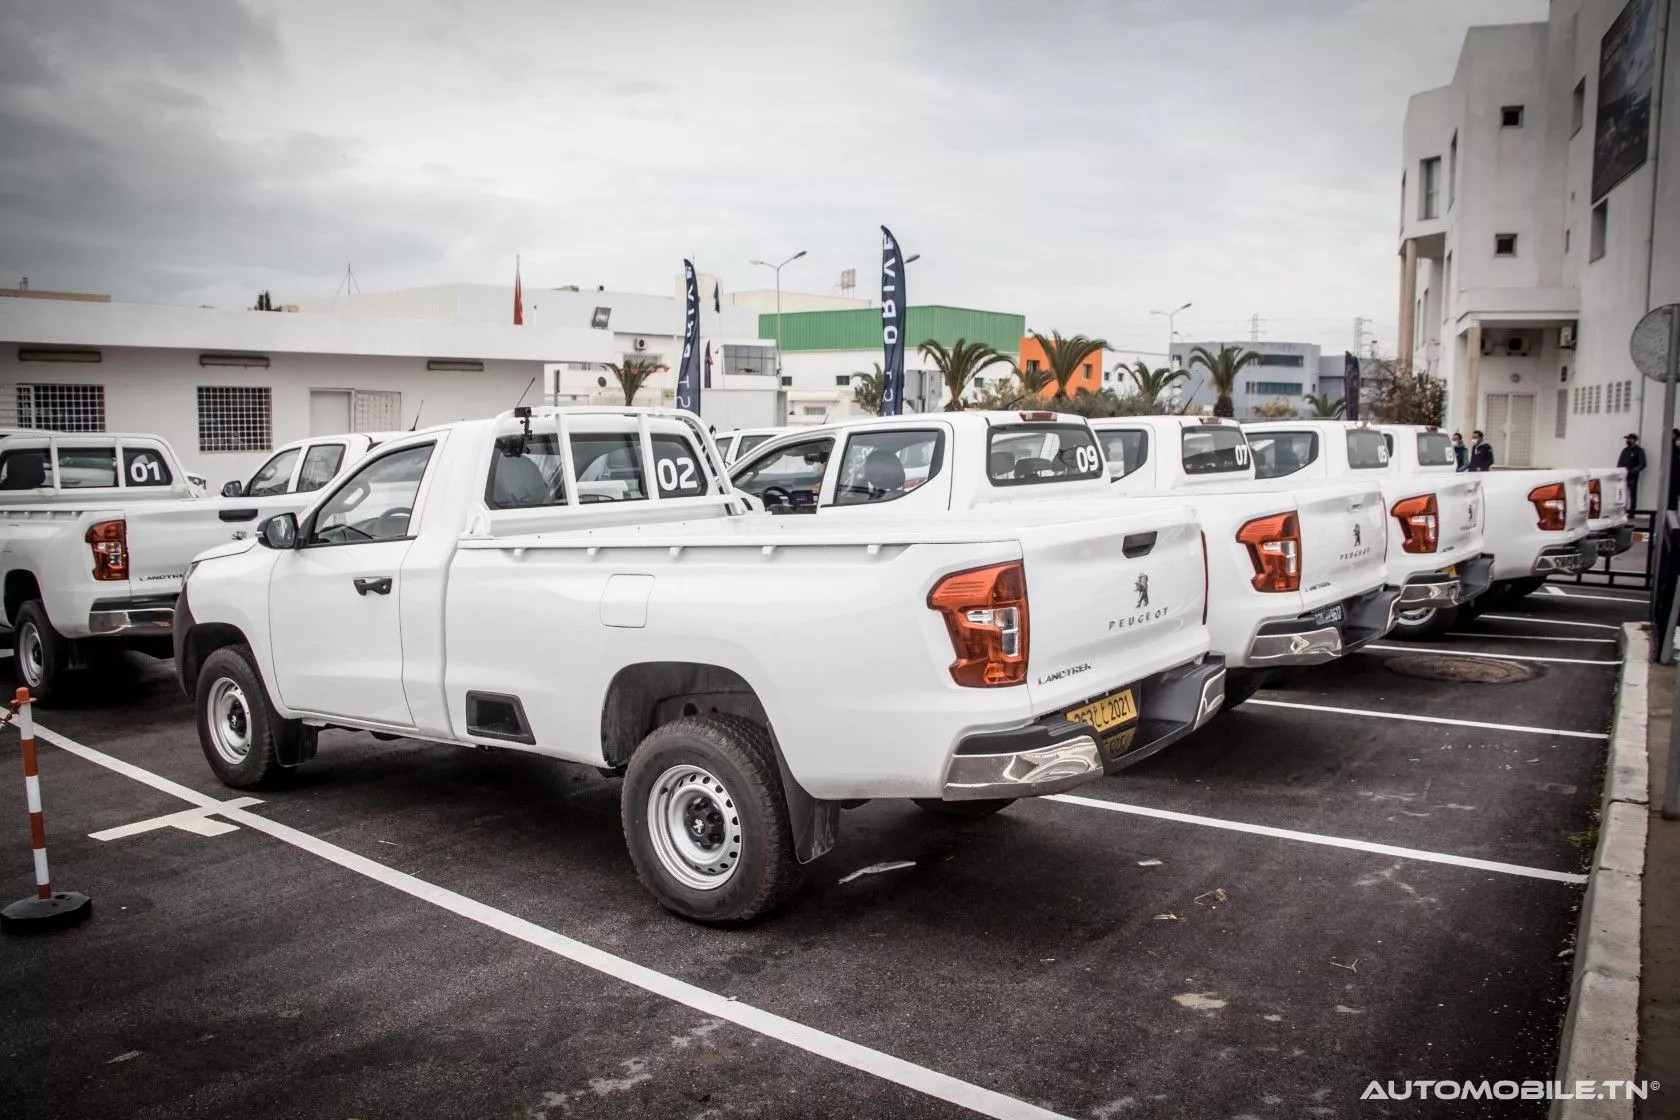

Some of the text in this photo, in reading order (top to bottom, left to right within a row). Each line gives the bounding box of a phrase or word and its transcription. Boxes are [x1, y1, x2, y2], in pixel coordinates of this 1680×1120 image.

[1076, 445, 1099, 473] 09
[1235, 444, 1248, 466] 07
[130, 461, 161, 482] 01
[657, 457, 698, 491] 02
[1108, 606, 1169, 631] PEUGEOT
[1037, 662, 1092, 686] LANDTREK
[1108, 694, 1131, 721] 2021
